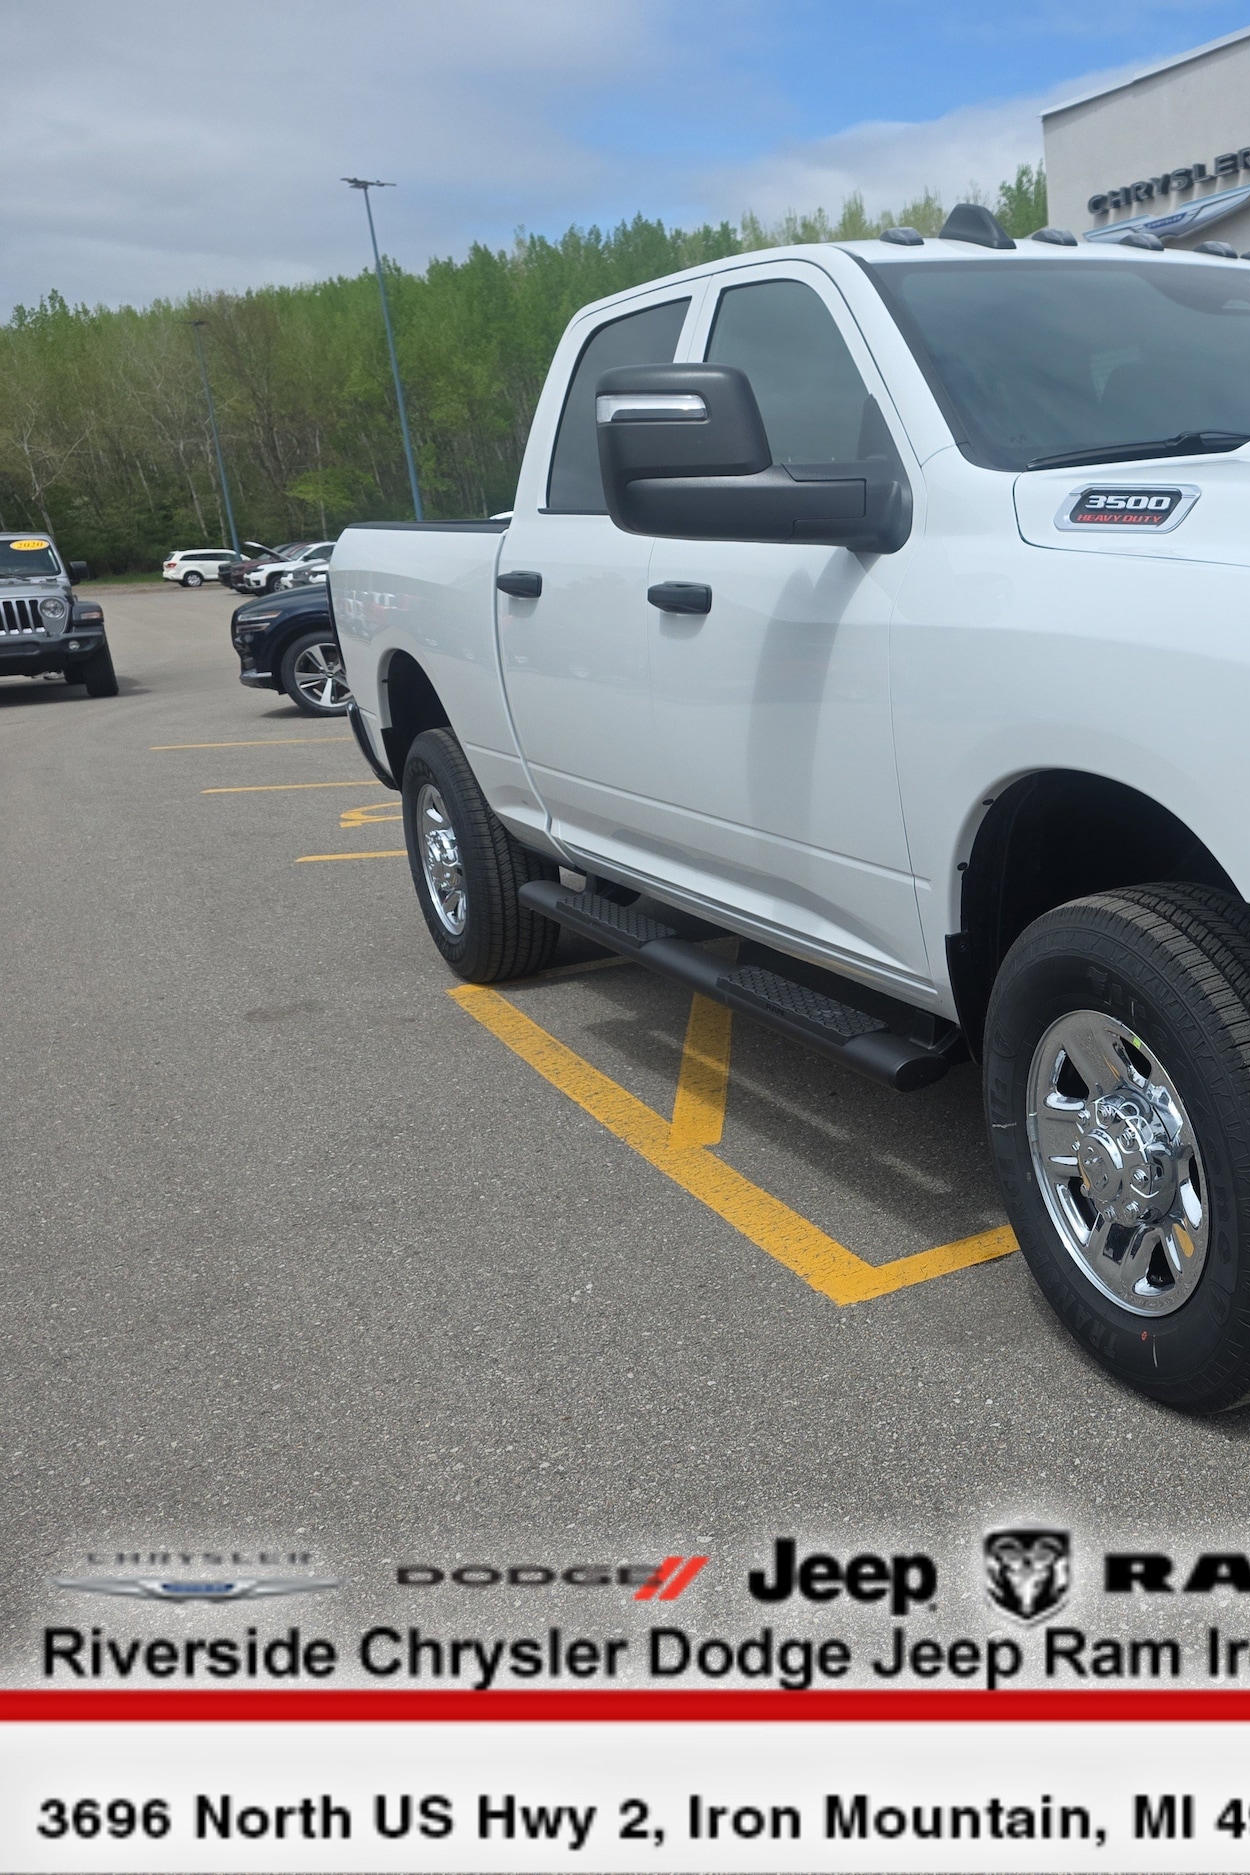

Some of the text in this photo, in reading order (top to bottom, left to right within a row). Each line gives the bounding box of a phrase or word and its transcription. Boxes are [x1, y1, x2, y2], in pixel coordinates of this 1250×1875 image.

[1084, 494, 1172, 511] 3500
[1076, 513, 1163, 524] HEAVY DUTY
